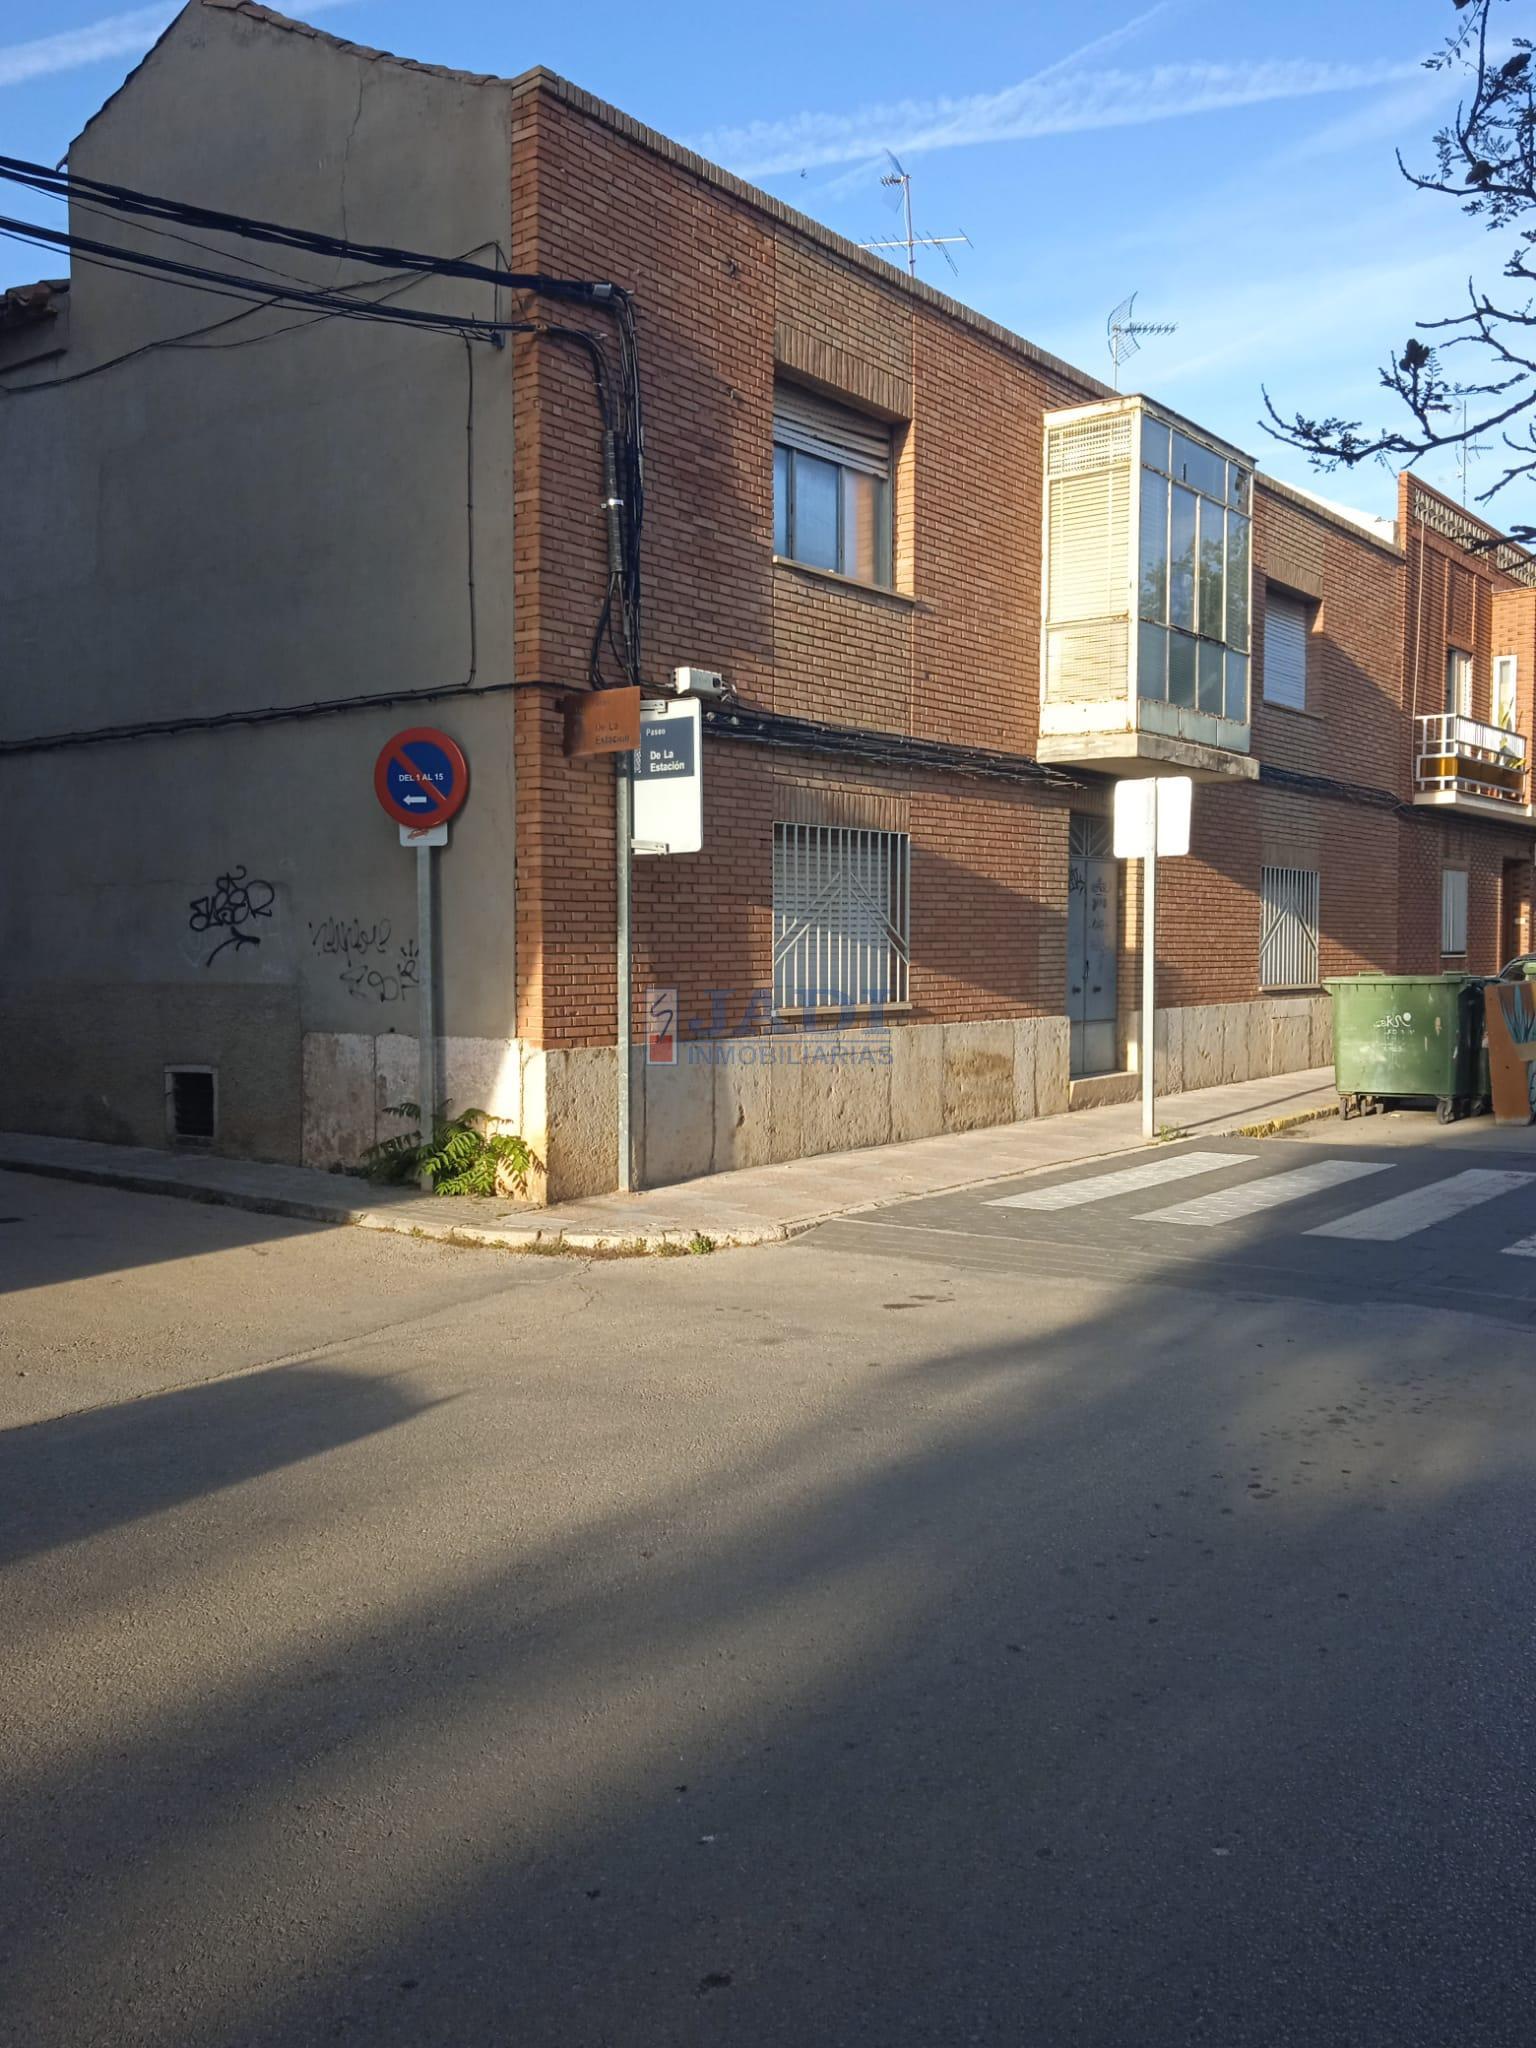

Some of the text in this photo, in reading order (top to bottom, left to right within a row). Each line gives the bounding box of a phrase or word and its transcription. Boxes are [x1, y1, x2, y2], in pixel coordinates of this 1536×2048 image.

[646, 728, 666, 736] Paseo
[650, 749, 674, 760] De La
[650, 761, 685, 772] Estación
[399, 772, 444, 782] DEL 1 AL 15
